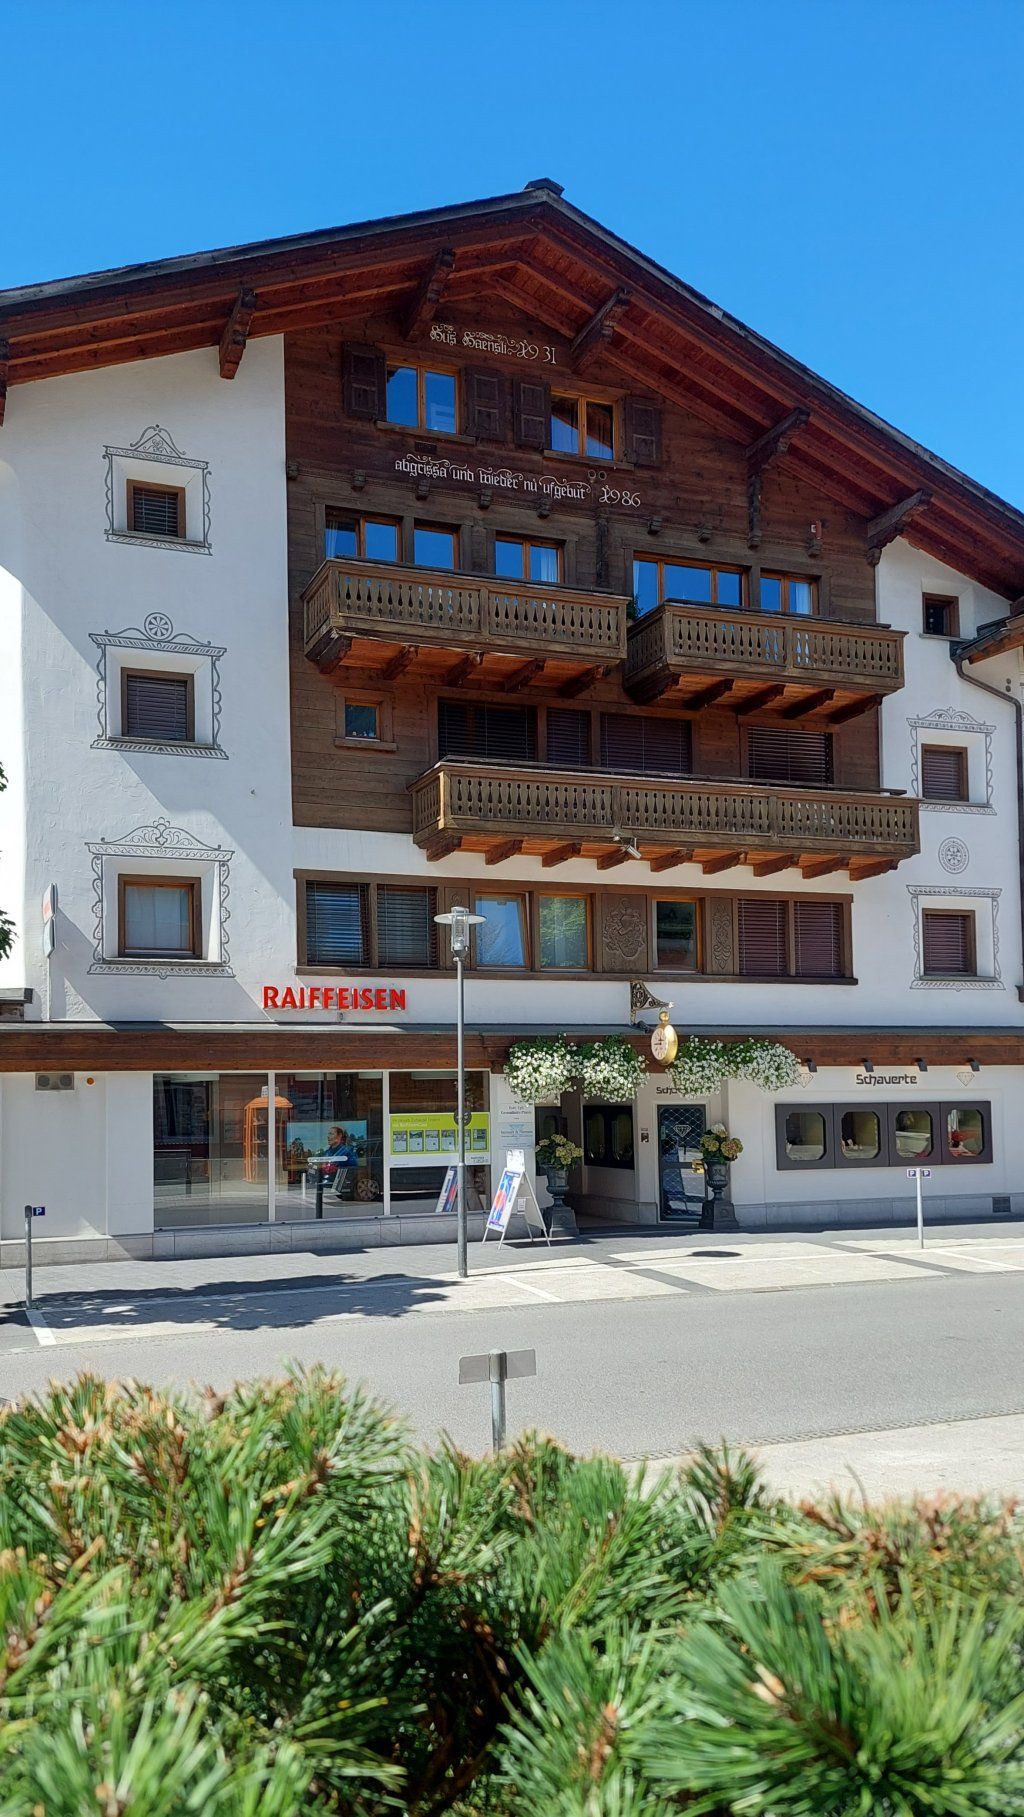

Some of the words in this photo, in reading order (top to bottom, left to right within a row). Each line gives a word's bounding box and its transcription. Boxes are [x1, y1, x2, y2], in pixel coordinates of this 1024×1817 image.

[395, 456, 447, 478] abgrissa
[451, 466, 474, 482] und
[479, 469, 519, 489] wieder
[263, 986, 406, 1010] RAIFFEISEN
[856, 1073, 917, 1086] Schauerte
